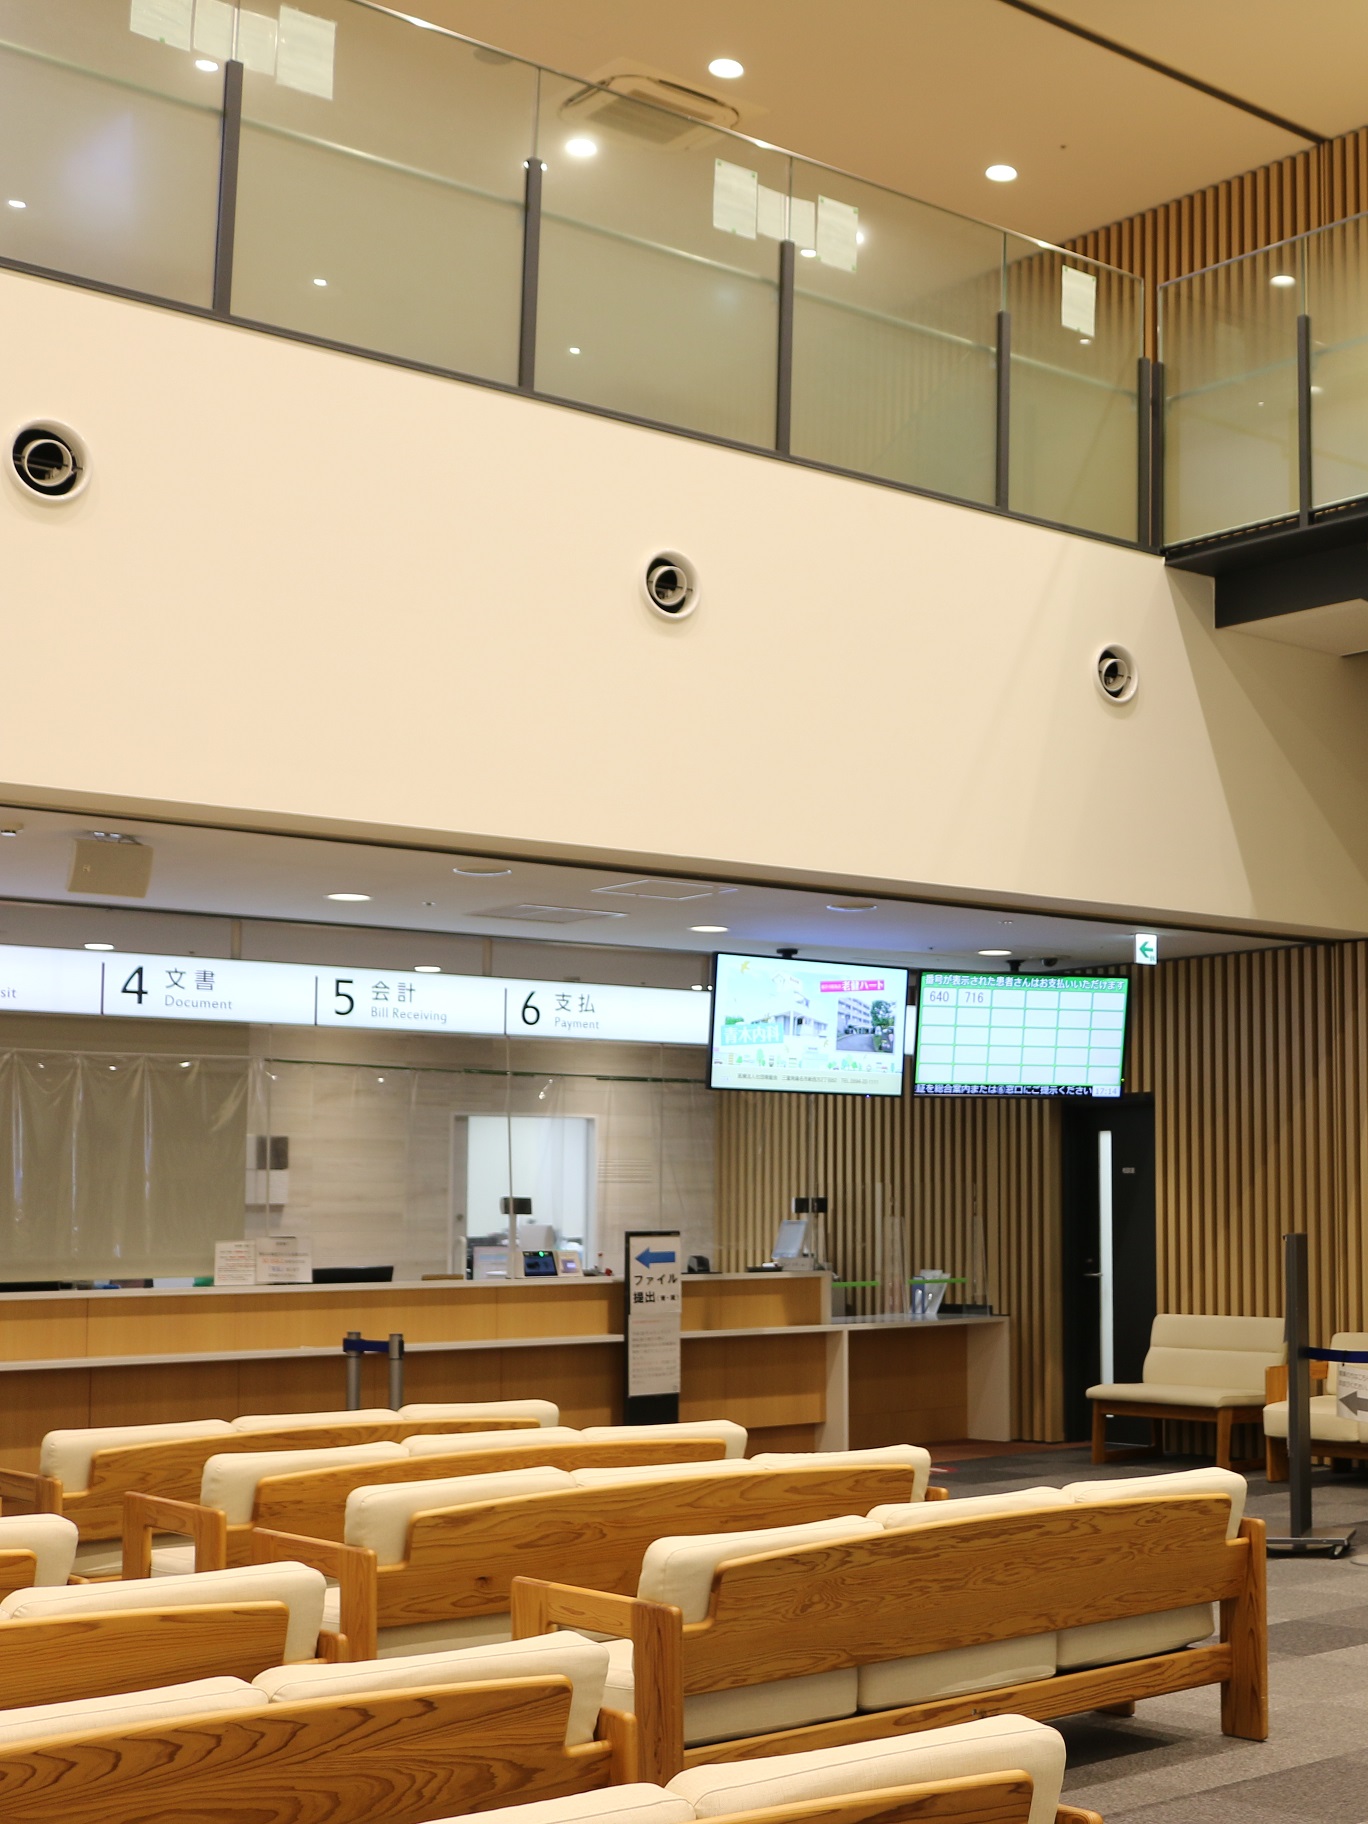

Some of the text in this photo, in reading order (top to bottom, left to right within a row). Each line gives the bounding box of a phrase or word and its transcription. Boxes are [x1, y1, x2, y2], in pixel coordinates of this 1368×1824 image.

[120, 966, 149, 1005] 4
[165, 968, 215, 991] 文書
[334, 979, 356, 1016] 5
[371, 980, 415, 1003] 会計
[929, 991, 950, 1003] 640
[964, 992, 984, 1004] 716
[164, 994, 233, 1011] Document
[521, 991, 541, 1026] 6
[555, 992, 597, 1014] 支払
[370, 1005, 448, 1025] Bill Receiving
[554, 1016, 600, 1031] Payment
[725, 1027, 780, 1043] 青木内科
[1095, 1087, 1117, 1096] 17:14
[633, 1274, 677, 1286] ファイル
